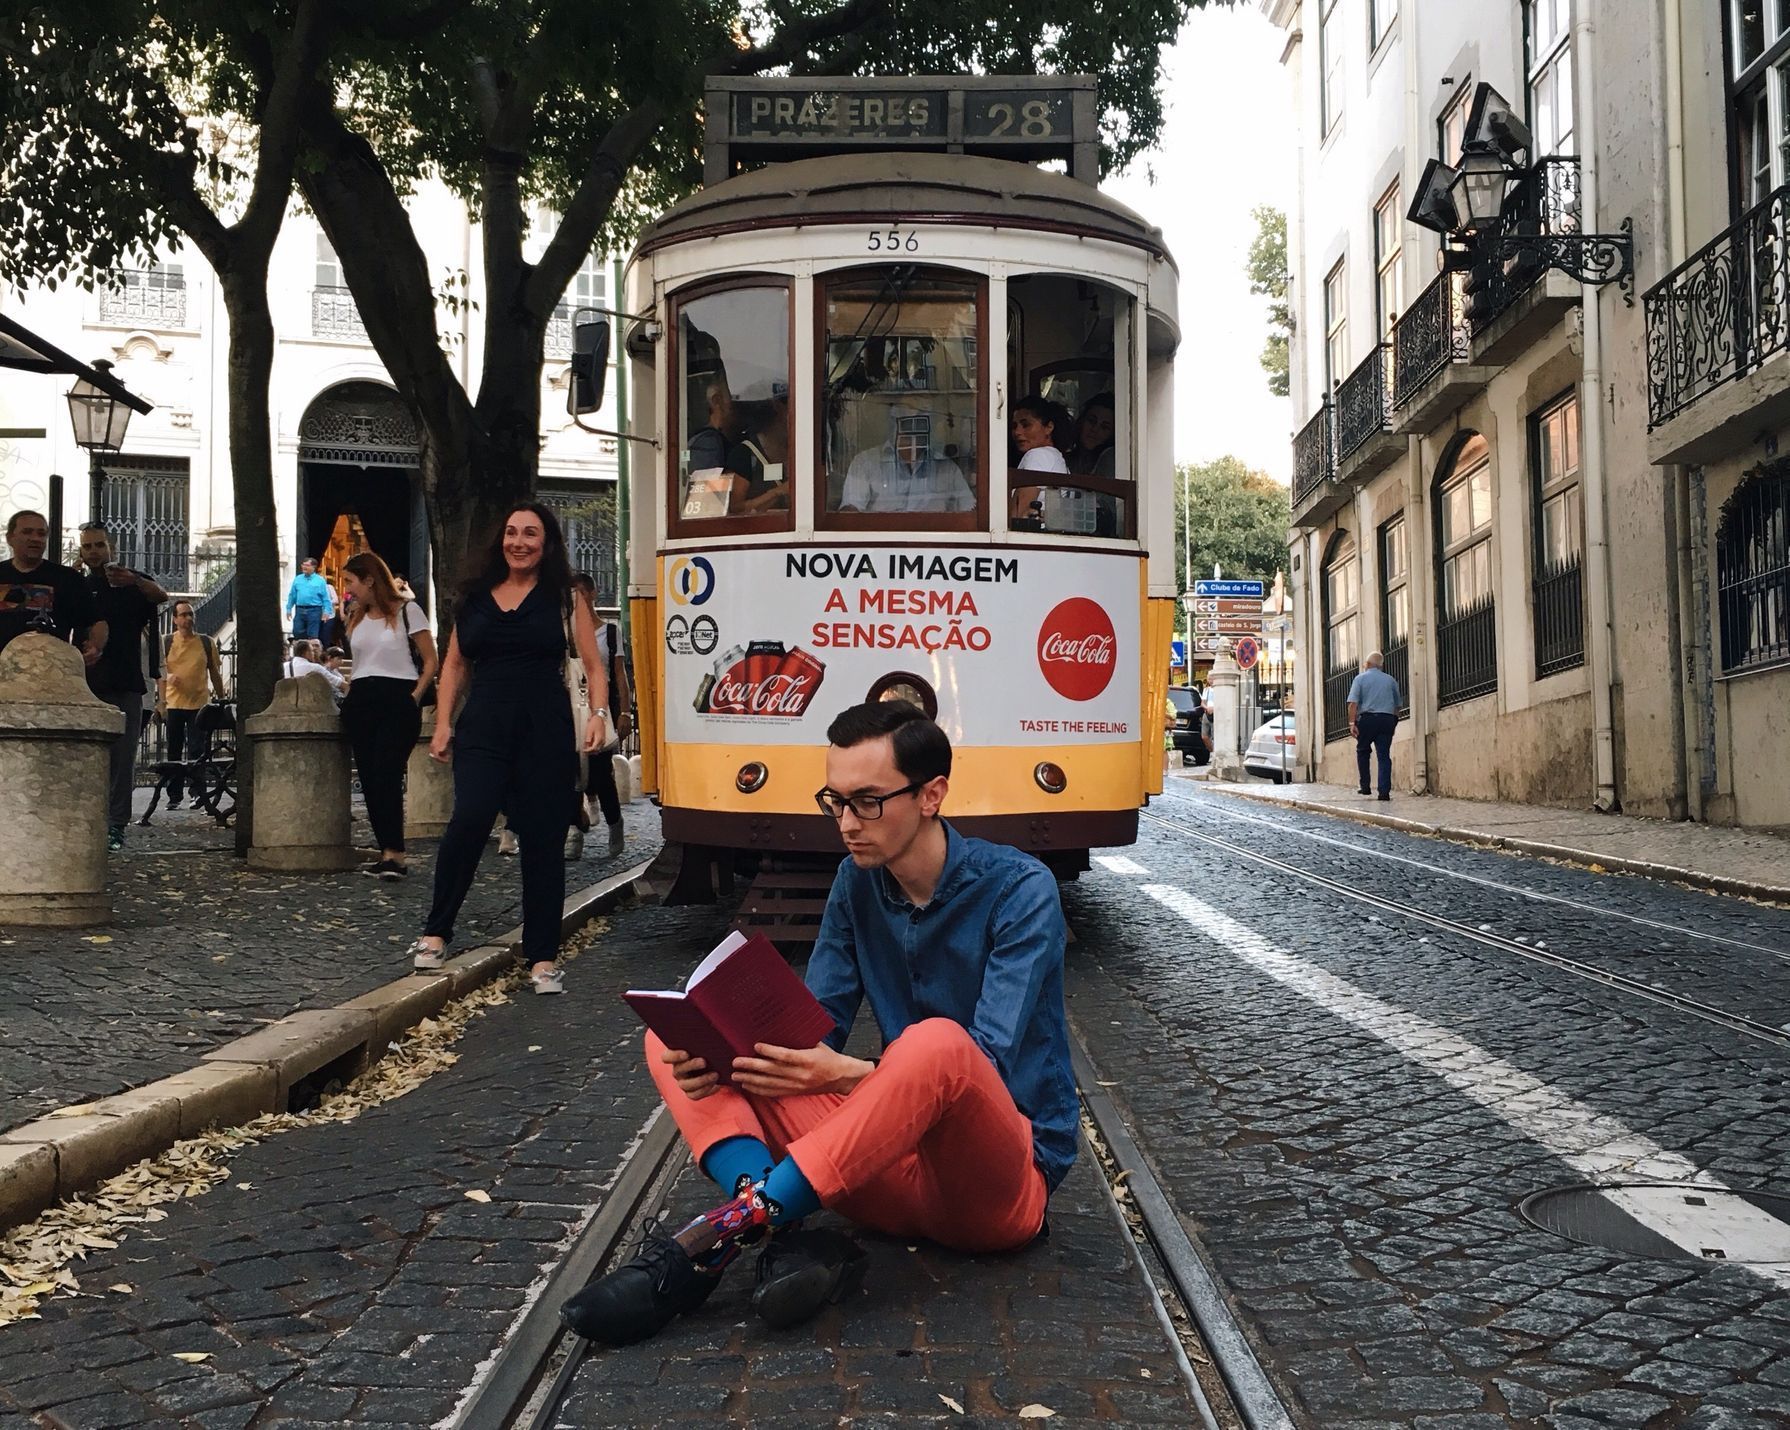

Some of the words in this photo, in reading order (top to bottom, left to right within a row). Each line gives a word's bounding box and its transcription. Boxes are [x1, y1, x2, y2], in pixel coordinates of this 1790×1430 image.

[750, 97, 929, 126] PRAZERES
[988, 100, 1053, 137] 28
[867, 230, 919, 252] 556
[685, 501, 701, 514] 03
[786, 553, 877, 578] NOVA
[889, 554, 1018, 583] IMAGEM
[824, 588, 848, 613] A
[859, 589, 979, 616] MESMA
[811, 619, 992, 655] SENSAÇÃO
[1041, 631, 1114, 664] Coca-Cola
[709, 673, 811, 713] Coca-Cola
[1019, 720, 1059, 732] TASTE
[1061, 721, 1084, 732] THE
[1086, 722, 1127, 734] FEELING
